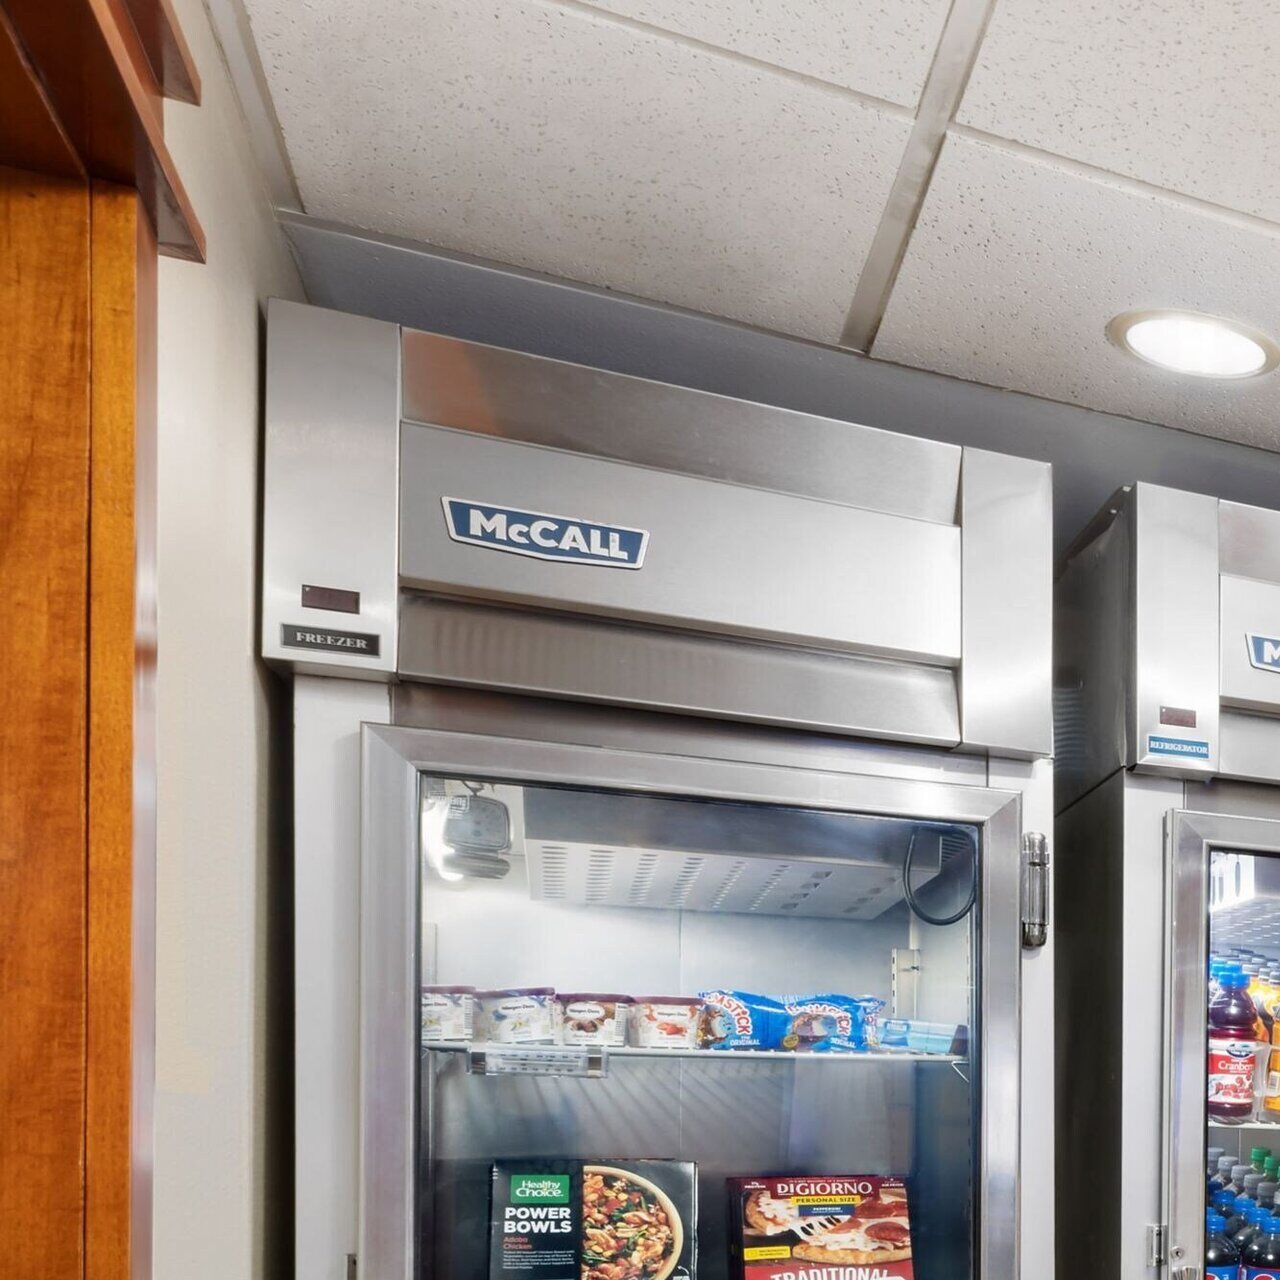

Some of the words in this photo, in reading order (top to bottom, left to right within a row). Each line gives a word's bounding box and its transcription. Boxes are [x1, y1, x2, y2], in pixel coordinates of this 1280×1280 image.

[468, 508, 628, 561] McCALL
[296, 632, 367, 650] FREEZER
[1149, 739, 1208, 755] REFRIGERATOR
[522, 1180, 560, 1190] Healthy
[505, 1207, 570, 1220] POWER
[504, 1221, 571, 1233] BOWLS
